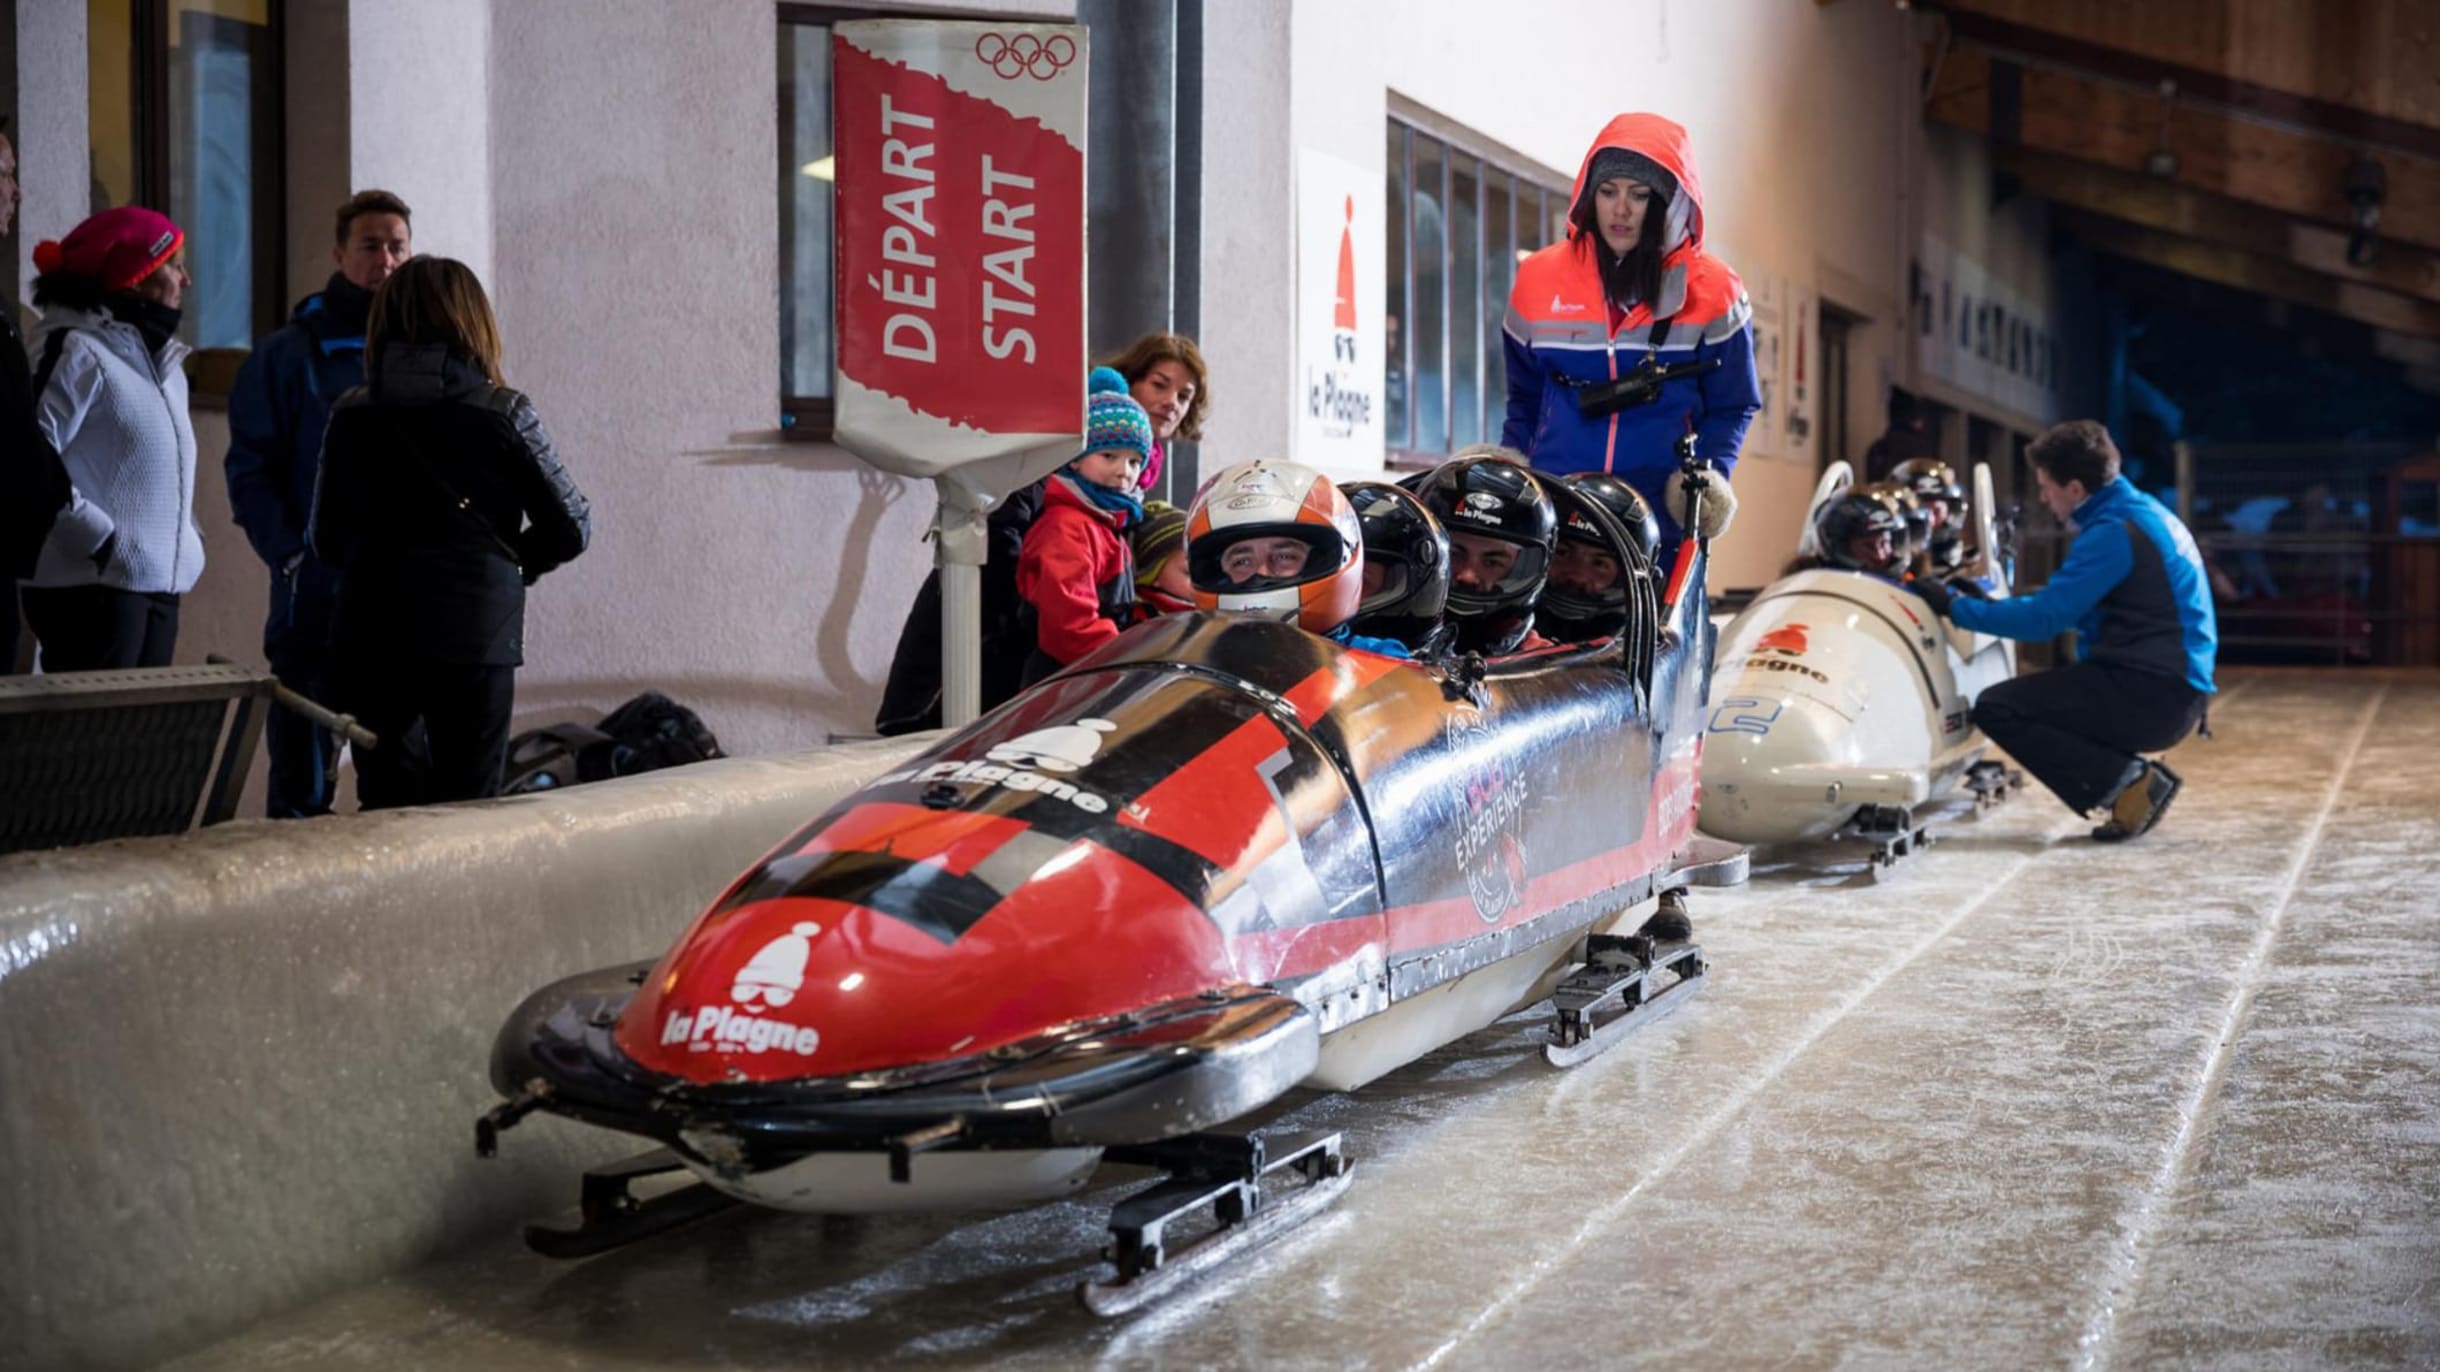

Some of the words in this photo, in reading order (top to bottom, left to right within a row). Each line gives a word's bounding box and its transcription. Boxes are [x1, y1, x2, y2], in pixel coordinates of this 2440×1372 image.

[868, 94, 936, 363] DÉPART
[982, 154, 1035, 364] START
[1308, 365, 1320, 418] la
[1324, 370, 1371, 438] Plagne
[1472, 509, 1502, 525] Plagne
[1708, 697, 1783, 735] 2
[911, 760, 1108, 813] Plagne
[1455, 770, 1529, 873] EXPERIENCE
[660, 1010, 693, 1046] la
[691, 1005, 820, 1056] Plagne
